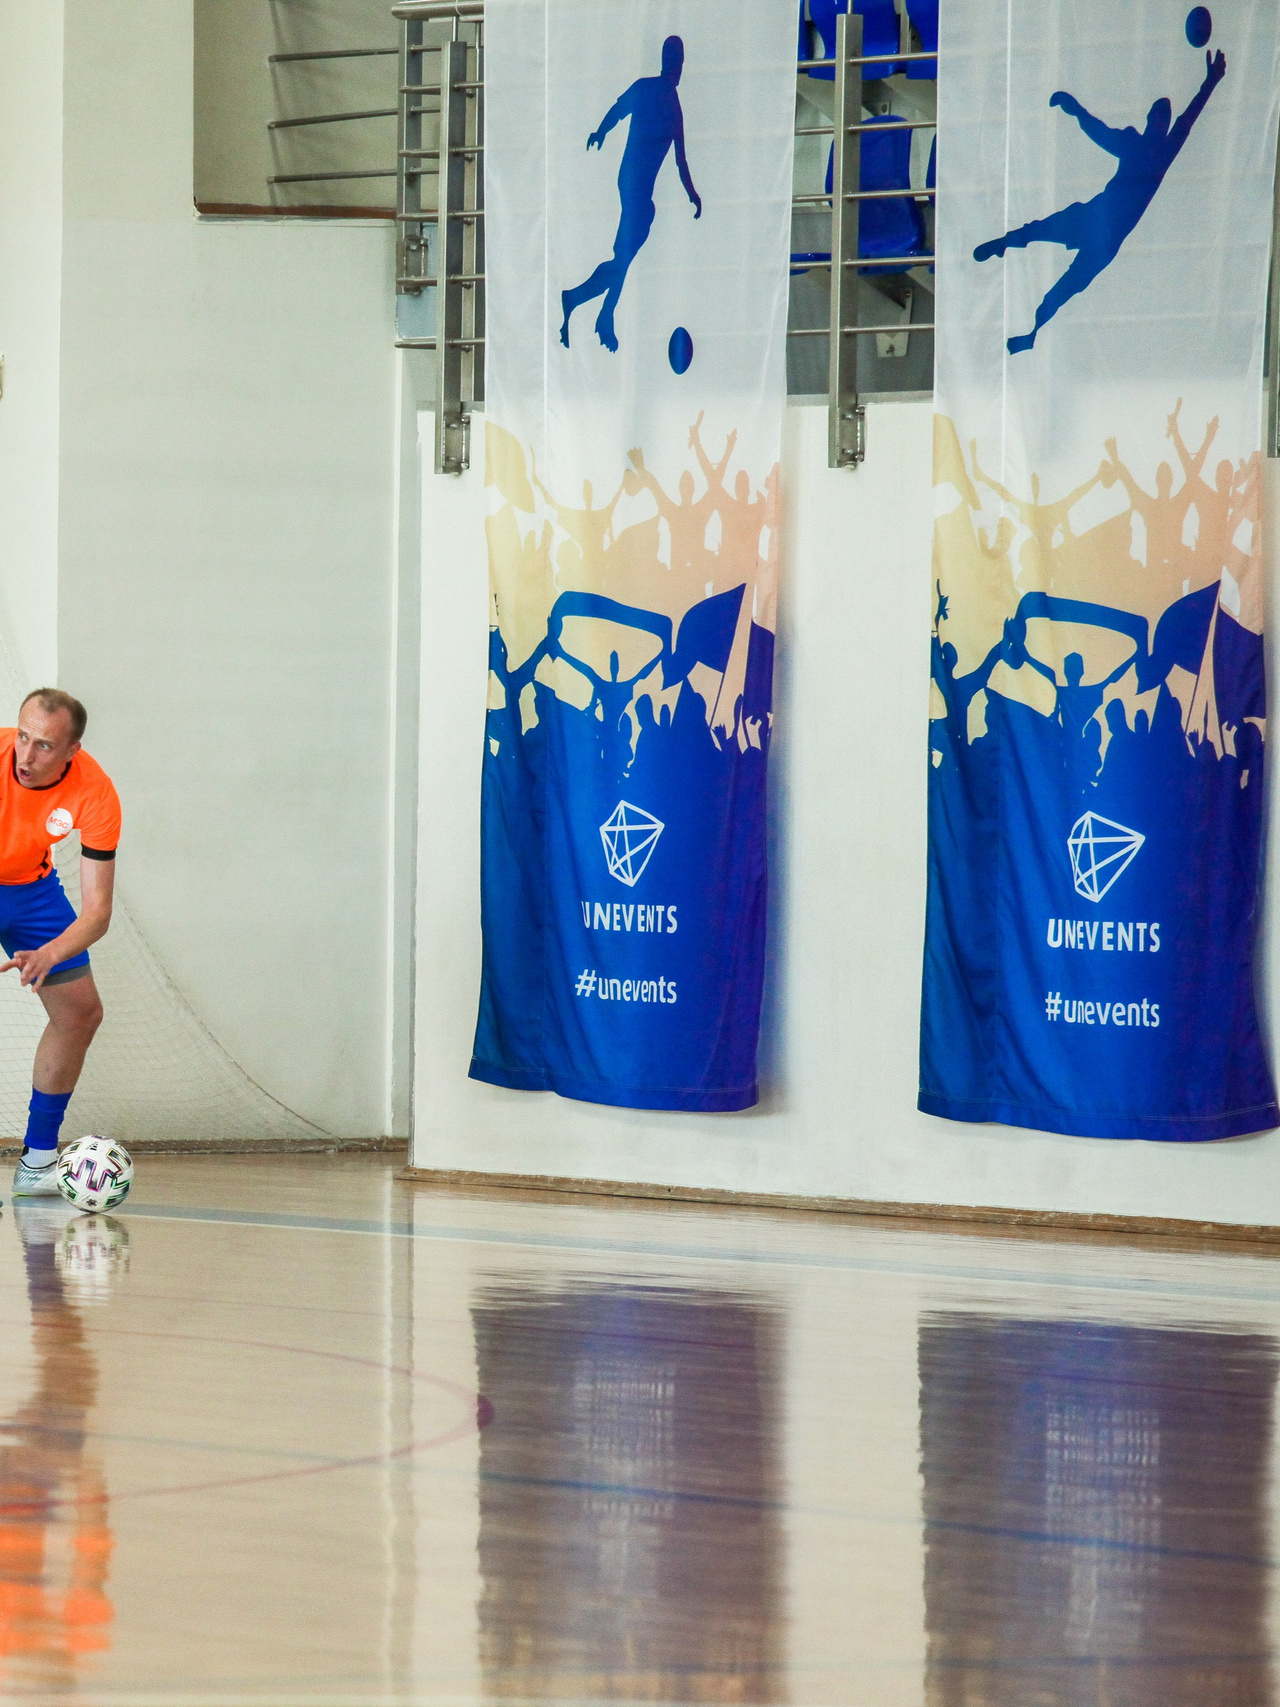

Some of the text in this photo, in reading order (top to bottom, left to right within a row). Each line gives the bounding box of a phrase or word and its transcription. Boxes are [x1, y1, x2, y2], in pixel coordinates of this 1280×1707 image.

[581, 900, 678, 934] UNEVENTS
[1046, 918, 1161, 953] UNEVENTS
[574, 969, 678, 1004] #unevents
[1045, 991, 1161, 1028] #unevents
